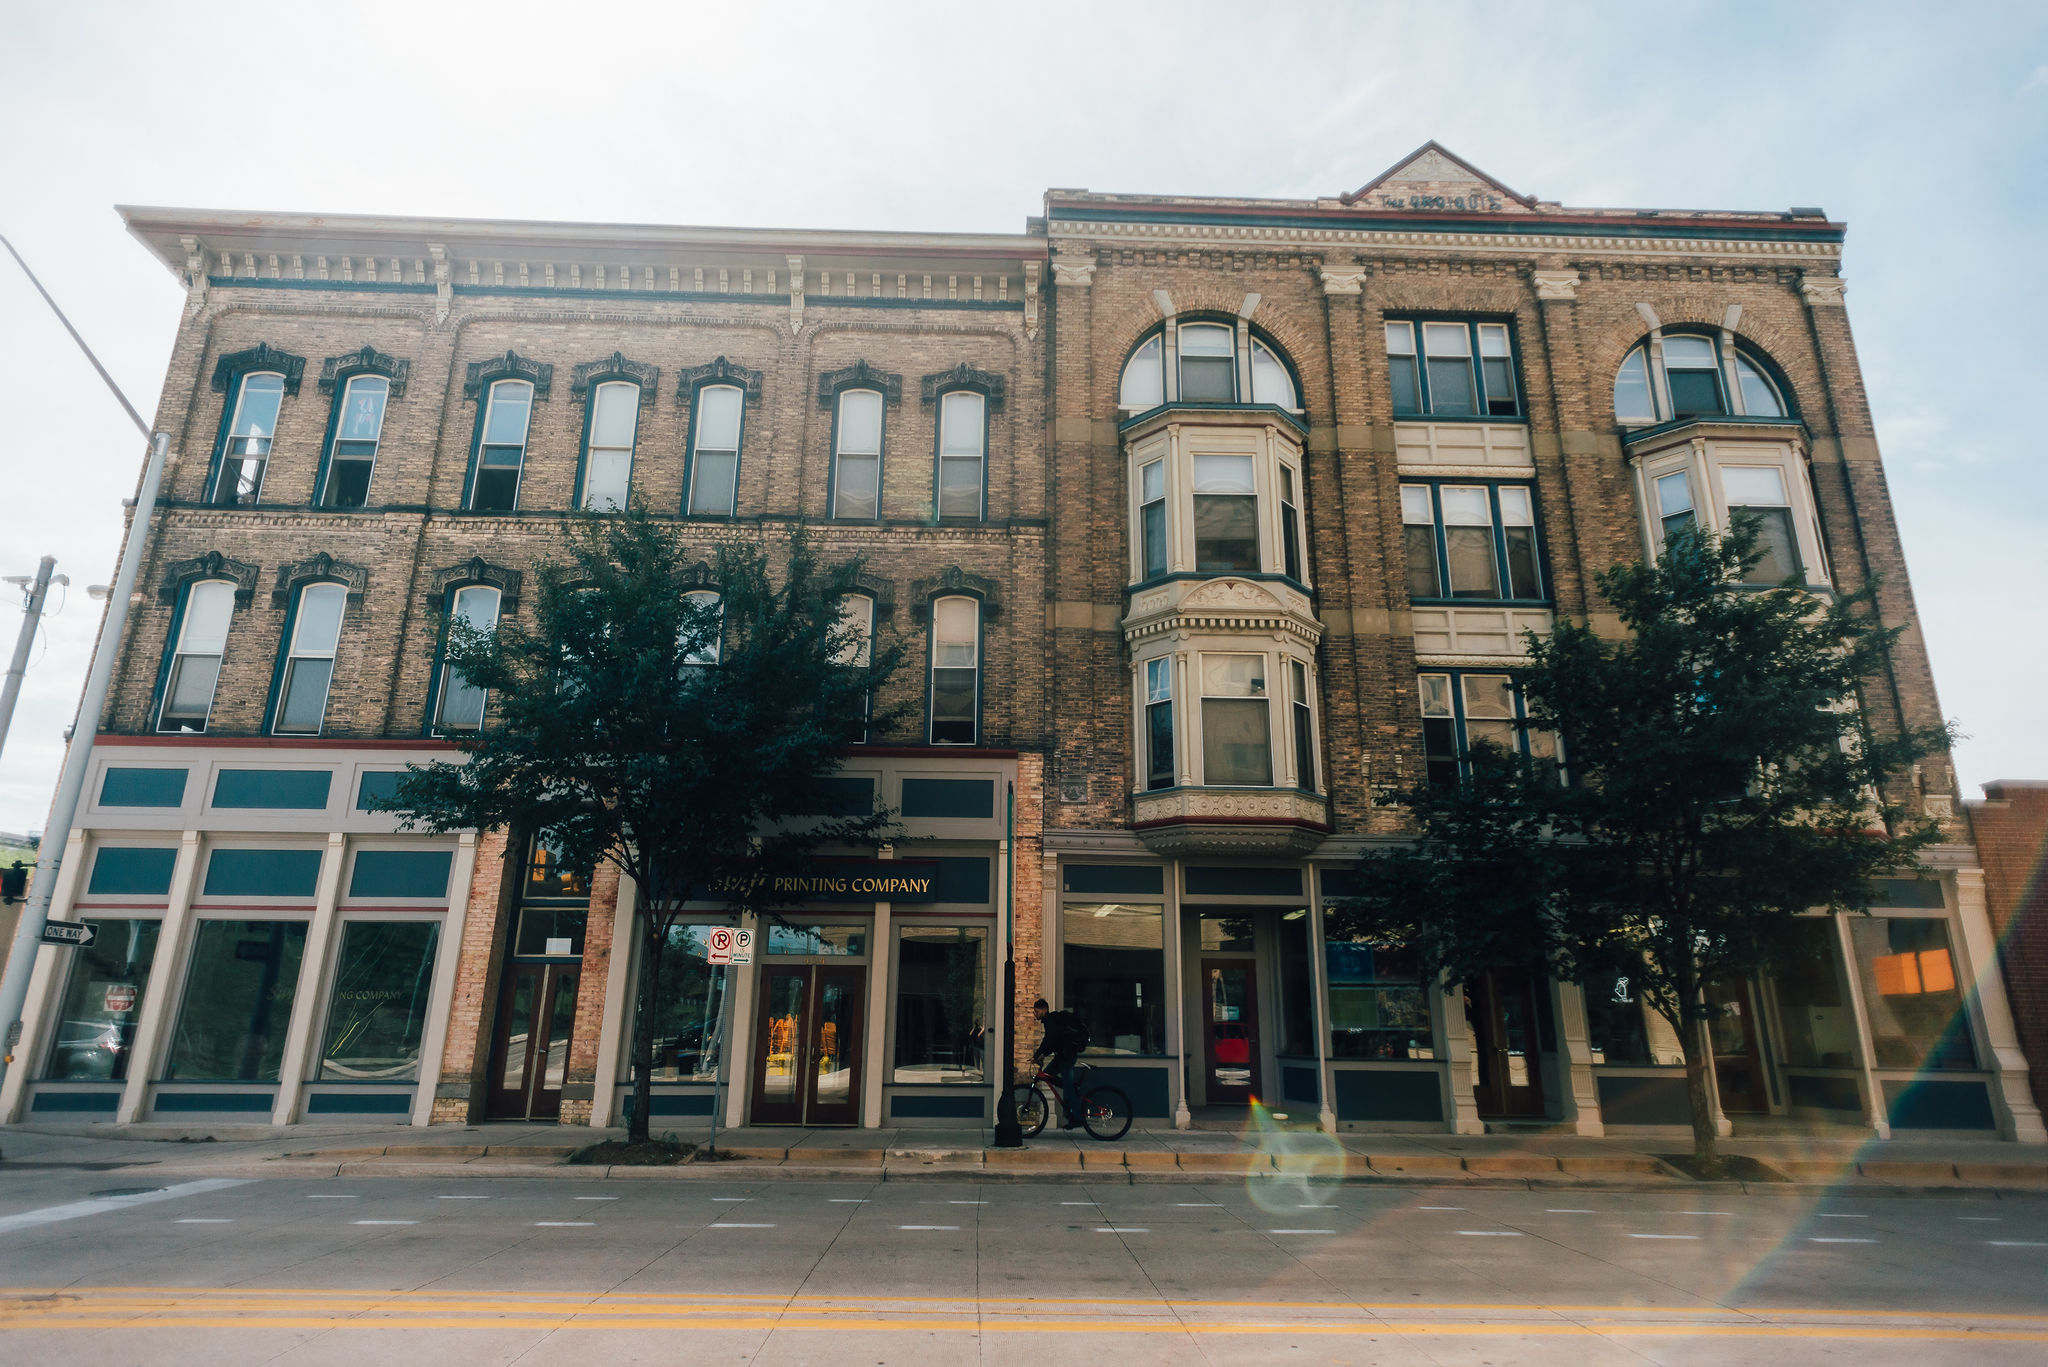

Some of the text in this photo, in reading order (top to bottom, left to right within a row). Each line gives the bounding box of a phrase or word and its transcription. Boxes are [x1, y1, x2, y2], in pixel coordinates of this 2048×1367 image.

[774, 877, 848, 893] PRINTING
[852, 877, 930, 893] COMPANY
[47, 926, 83, 938] ONE WAY
[355, 990, 401, 1001] COMPANY
